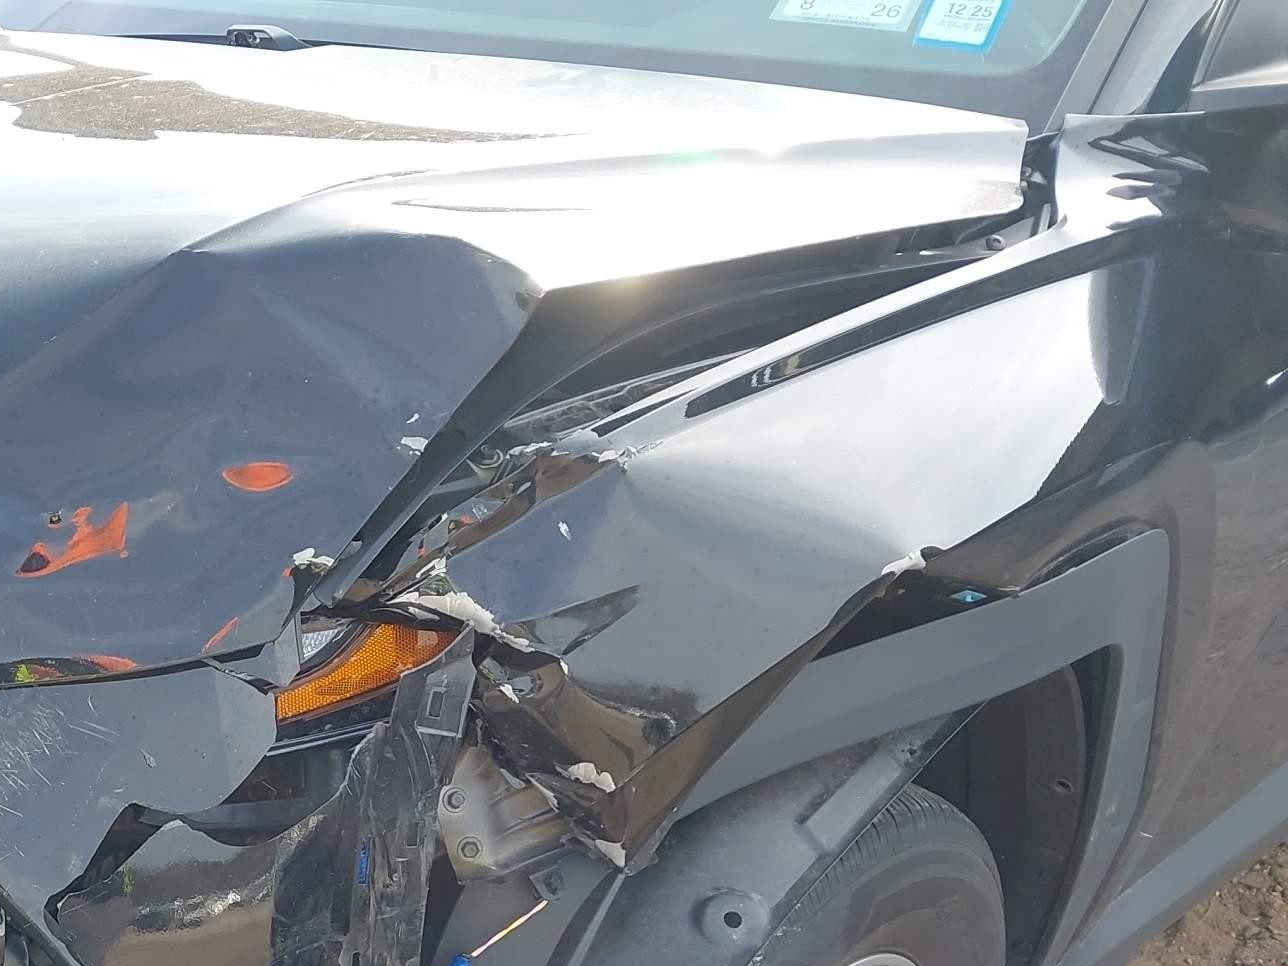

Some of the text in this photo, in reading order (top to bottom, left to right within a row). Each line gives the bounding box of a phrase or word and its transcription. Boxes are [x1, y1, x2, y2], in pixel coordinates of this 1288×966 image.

[870, 3, 902, 18] 26
[948, 2, 967, 15] 12
[970, 4, 995, 18] 25
